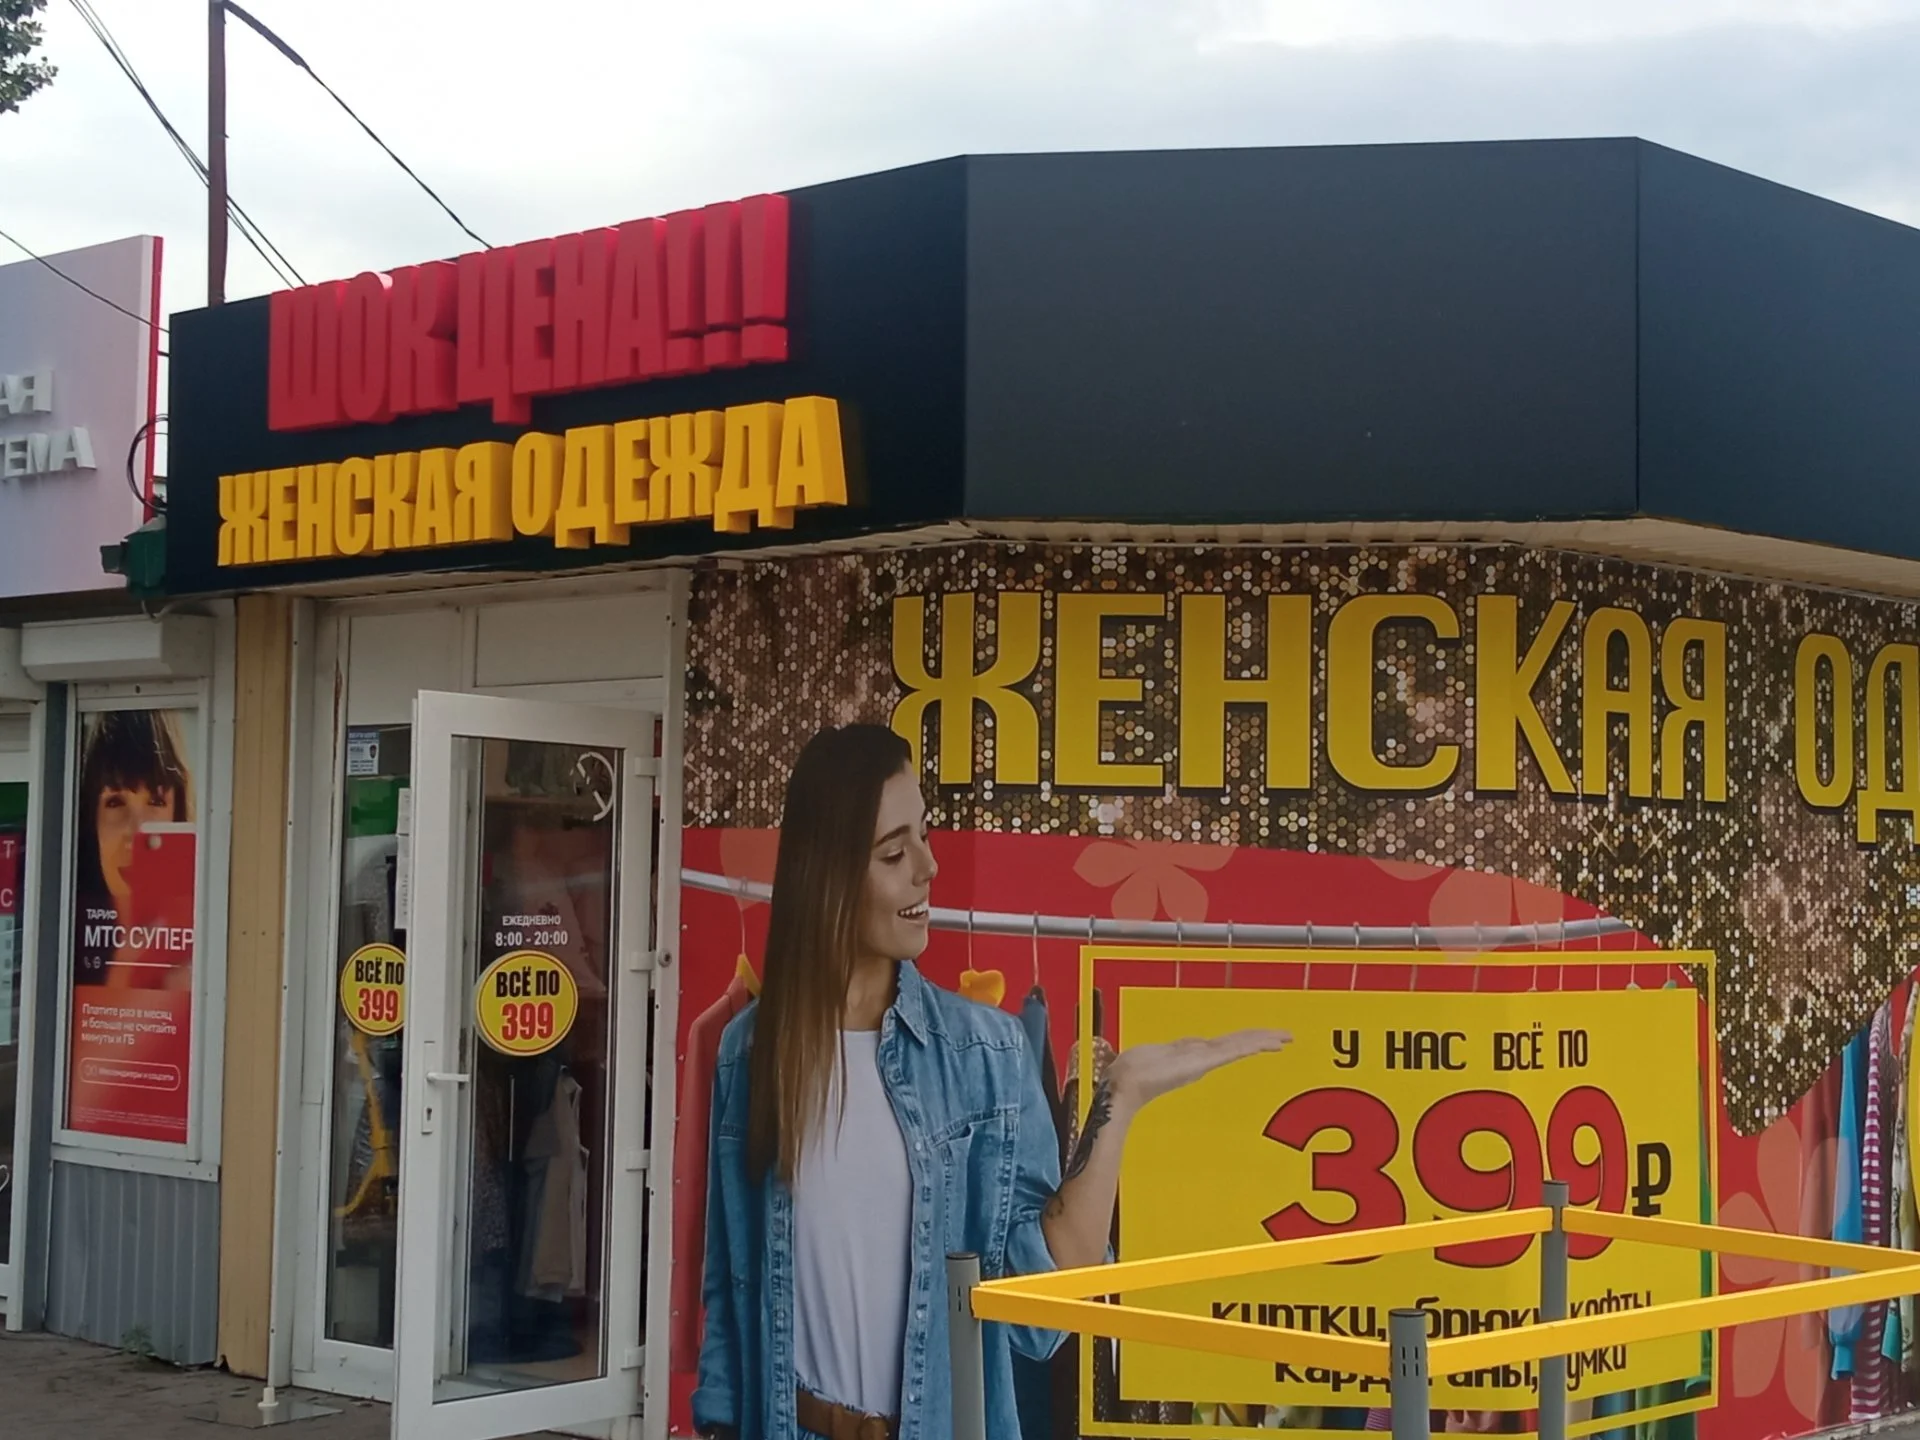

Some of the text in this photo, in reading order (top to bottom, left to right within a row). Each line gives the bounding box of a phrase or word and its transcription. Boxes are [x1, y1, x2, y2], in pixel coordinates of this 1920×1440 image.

[269, 194, 788, 431] ШОК ЦЕНА!!!
[0, 426, 97, 477] ЕМА
[217, 395, 847, 567] ЖЕНСКАЯ ОДЕЖДА
[890, 592, 1728, 804] ЖЕНСКАЯ
[86, 908, 118, 920] ТАРИФ
[502, 915, 561, 927] ЕЖЕДНЕВНО
[84, 925, 194, 951] МТС СУПЕР
[495, 931, 523, 946] 8:00
[534, 930, 568, 946] 20:00
[355, 957, 404, 985] ВСЁ ПО
[496, 966, 560, 998] ВСЁ ПО
[357, 988, 399, 1023] 399
[501, 1002, 555, 1042] 399
[123, 1033, 135, 1045] ГБ
[1332, 1022, 1588, 1071] У НАС ВСЁ ПО
[1416, 1296, 1540, 1339] брюк
[1567, 1344, 1627, 1391] умки
